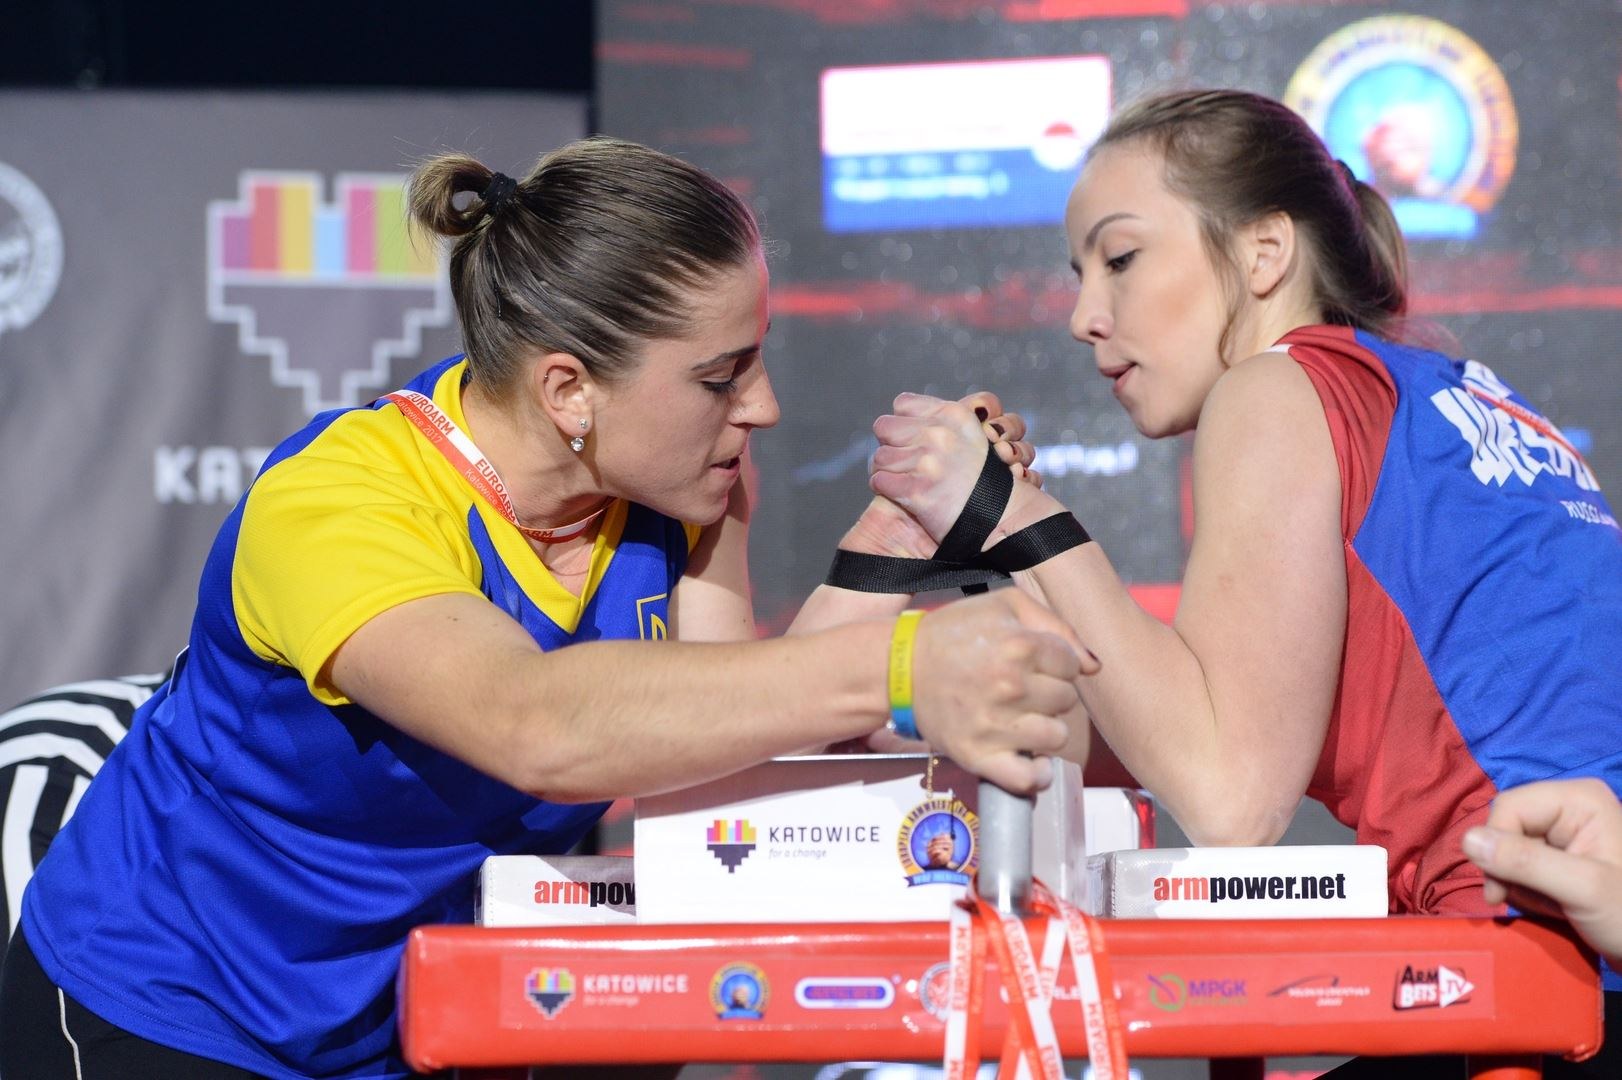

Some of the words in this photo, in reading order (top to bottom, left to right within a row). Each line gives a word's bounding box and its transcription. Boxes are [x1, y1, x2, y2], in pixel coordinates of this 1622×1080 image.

[407, 393, 455, 435] EUROARM
[423, 424, 442, 443] 2017
[464, 468, 498, 506] Katowice
[475, 458, 517, 521] EUROARM
[769, 826, 880, 842] KATOWICE
[769, 848, 781, 860] for
[784, 850, 790, 858] a
[793, 848, 827, 860] change
[1153, 873, 1346, 903] armpower.net
[583, 974, 688, 993] KATOWICE
[1188, 979, 1248, 997] MPGK
